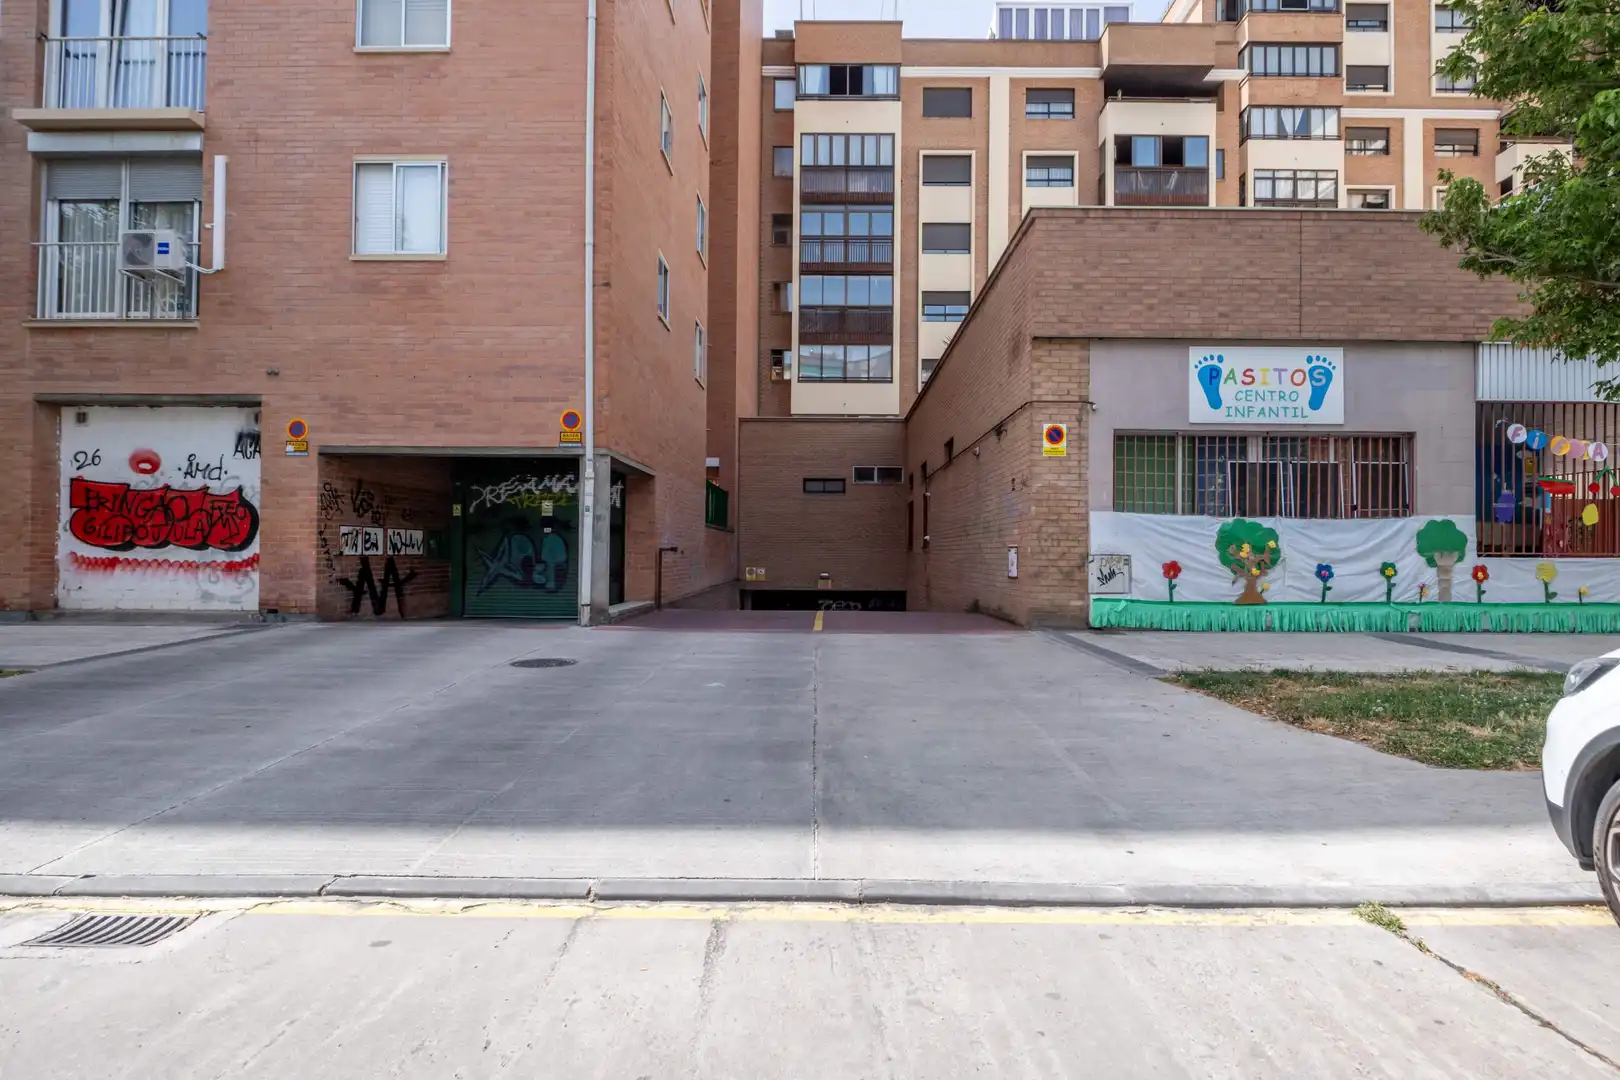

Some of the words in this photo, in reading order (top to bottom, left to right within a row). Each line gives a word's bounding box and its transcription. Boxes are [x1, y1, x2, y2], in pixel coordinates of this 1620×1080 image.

[1208, 367, 1327, 387] PASITOS
[1234, 390, 1300, 402] CENTRO
[1225, 405, 1309, 418] INFANTIL
[73, 448, 102, 471] 26
